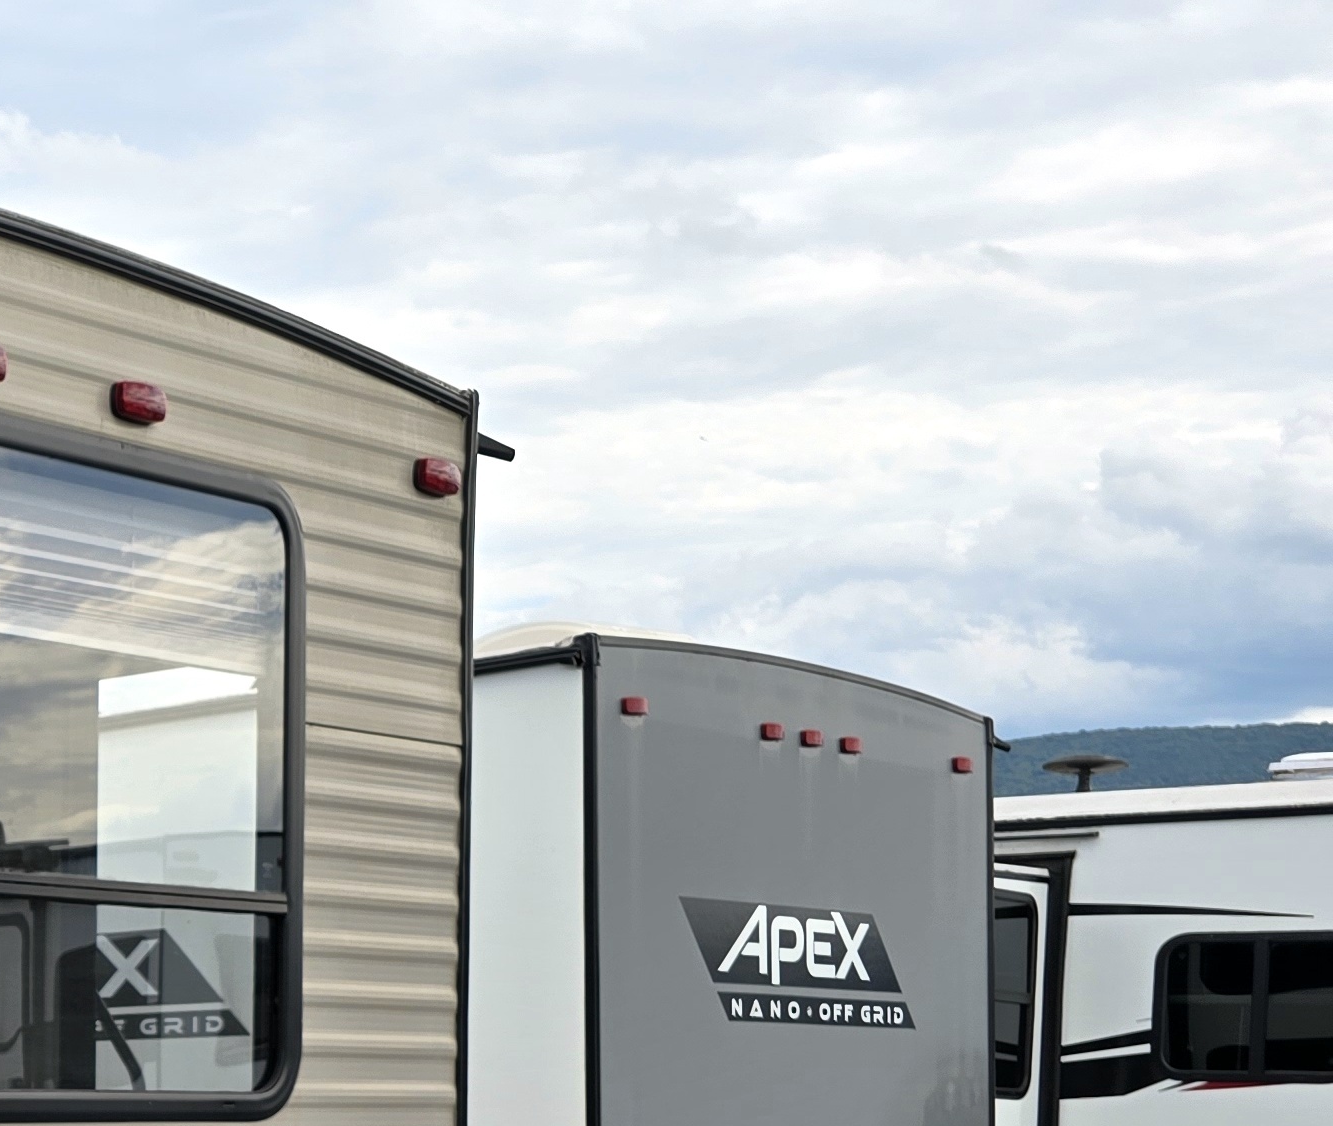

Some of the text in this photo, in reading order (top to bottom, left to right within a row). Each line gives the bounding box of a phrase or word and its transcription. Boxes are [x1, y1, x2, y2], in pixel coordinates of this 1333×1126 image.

[717, 904, 871, 986] APEX
[731, 997, 904, 1025] NANO OFF GRID
[139, 1015, 225, 1036] GRID
